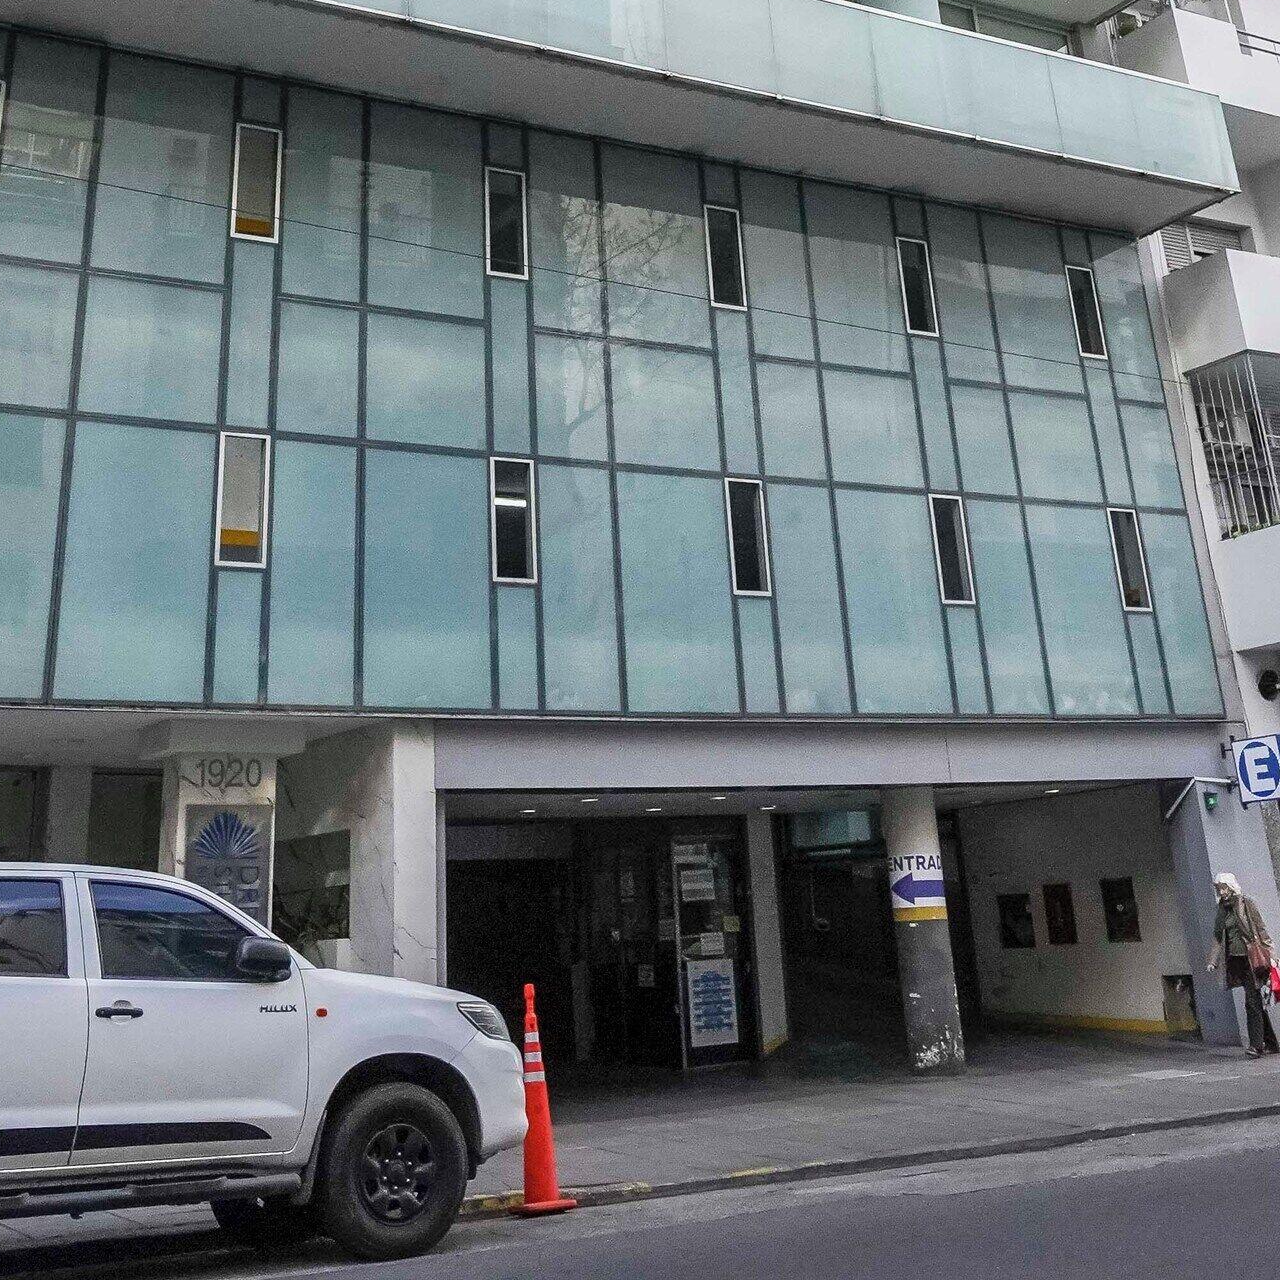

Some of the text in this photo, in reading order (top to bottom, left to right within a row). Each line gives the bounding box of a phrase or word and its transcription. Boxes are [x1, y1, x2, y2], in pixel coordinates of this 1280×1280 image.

[196, 758, 261, 788] 1920
[1244, 746, 1276, 793] E
[260, 1004, 297, 1013] HILUX
